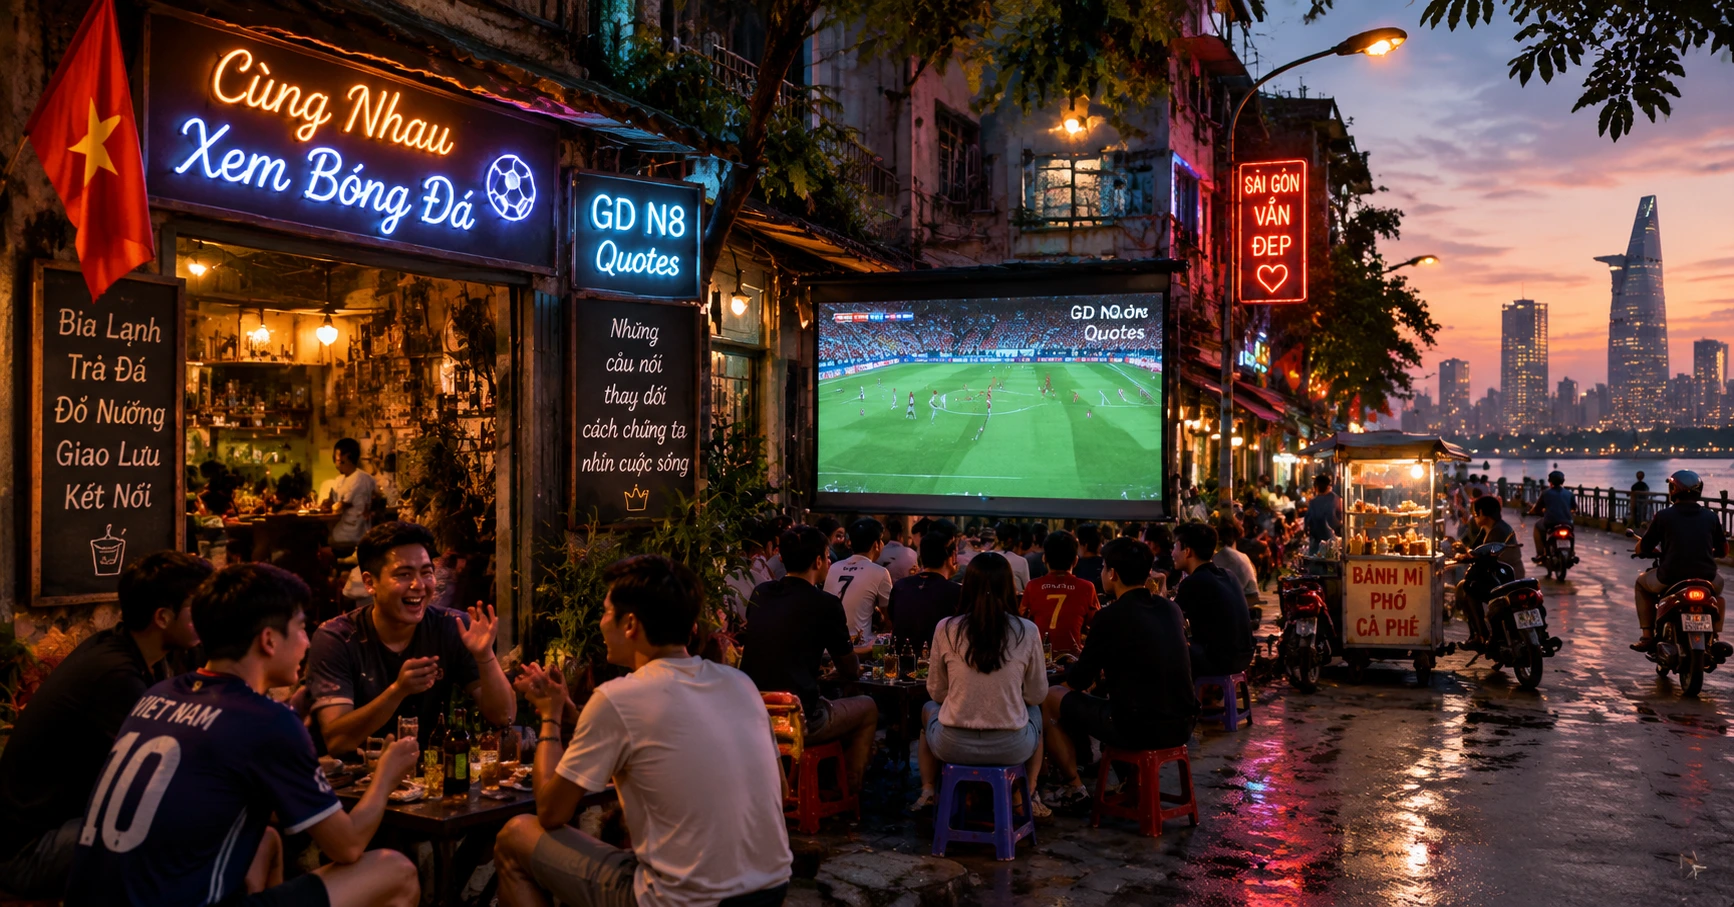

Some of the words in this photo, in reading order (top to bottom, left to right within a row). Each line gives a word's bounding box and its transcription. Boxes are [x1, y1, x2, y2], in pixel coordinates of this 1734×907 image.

[213, 49, 332, 141] Cùng
[345, 84, 454, 155] Nhau
[175, 117, 291, 192] Xem
[304, 147, 412, 234] Bóng
[421, 175, 475, 230] Đá
[592, 193, 636, 231] GD
[647, 201, 686, 238] N8
[596, 239, 680, 277] Quotes
[59, 308, 97, 337] Bia
[106, 312, 161, 347] Lạnh
[1070, 304, 1096, 320] GD
[1084, 324, 1145, 342] Quotes
[114, 356, 147, 383] Đá
[639, 353, 663, 374] nói
[604, 383, 639, 412] thay
[671, 420, 688, 439] ta
[56, 439, 110, 467] Giao
[118, 440, 161, 467] Lưu
[838, 575, 855, 602] 7
[1046, 594, 1068, 629] 7
[131, 695, 176, 720] VIET
[167, 702, 223, 731] NAM
[79, 731, 182, 853] 10
